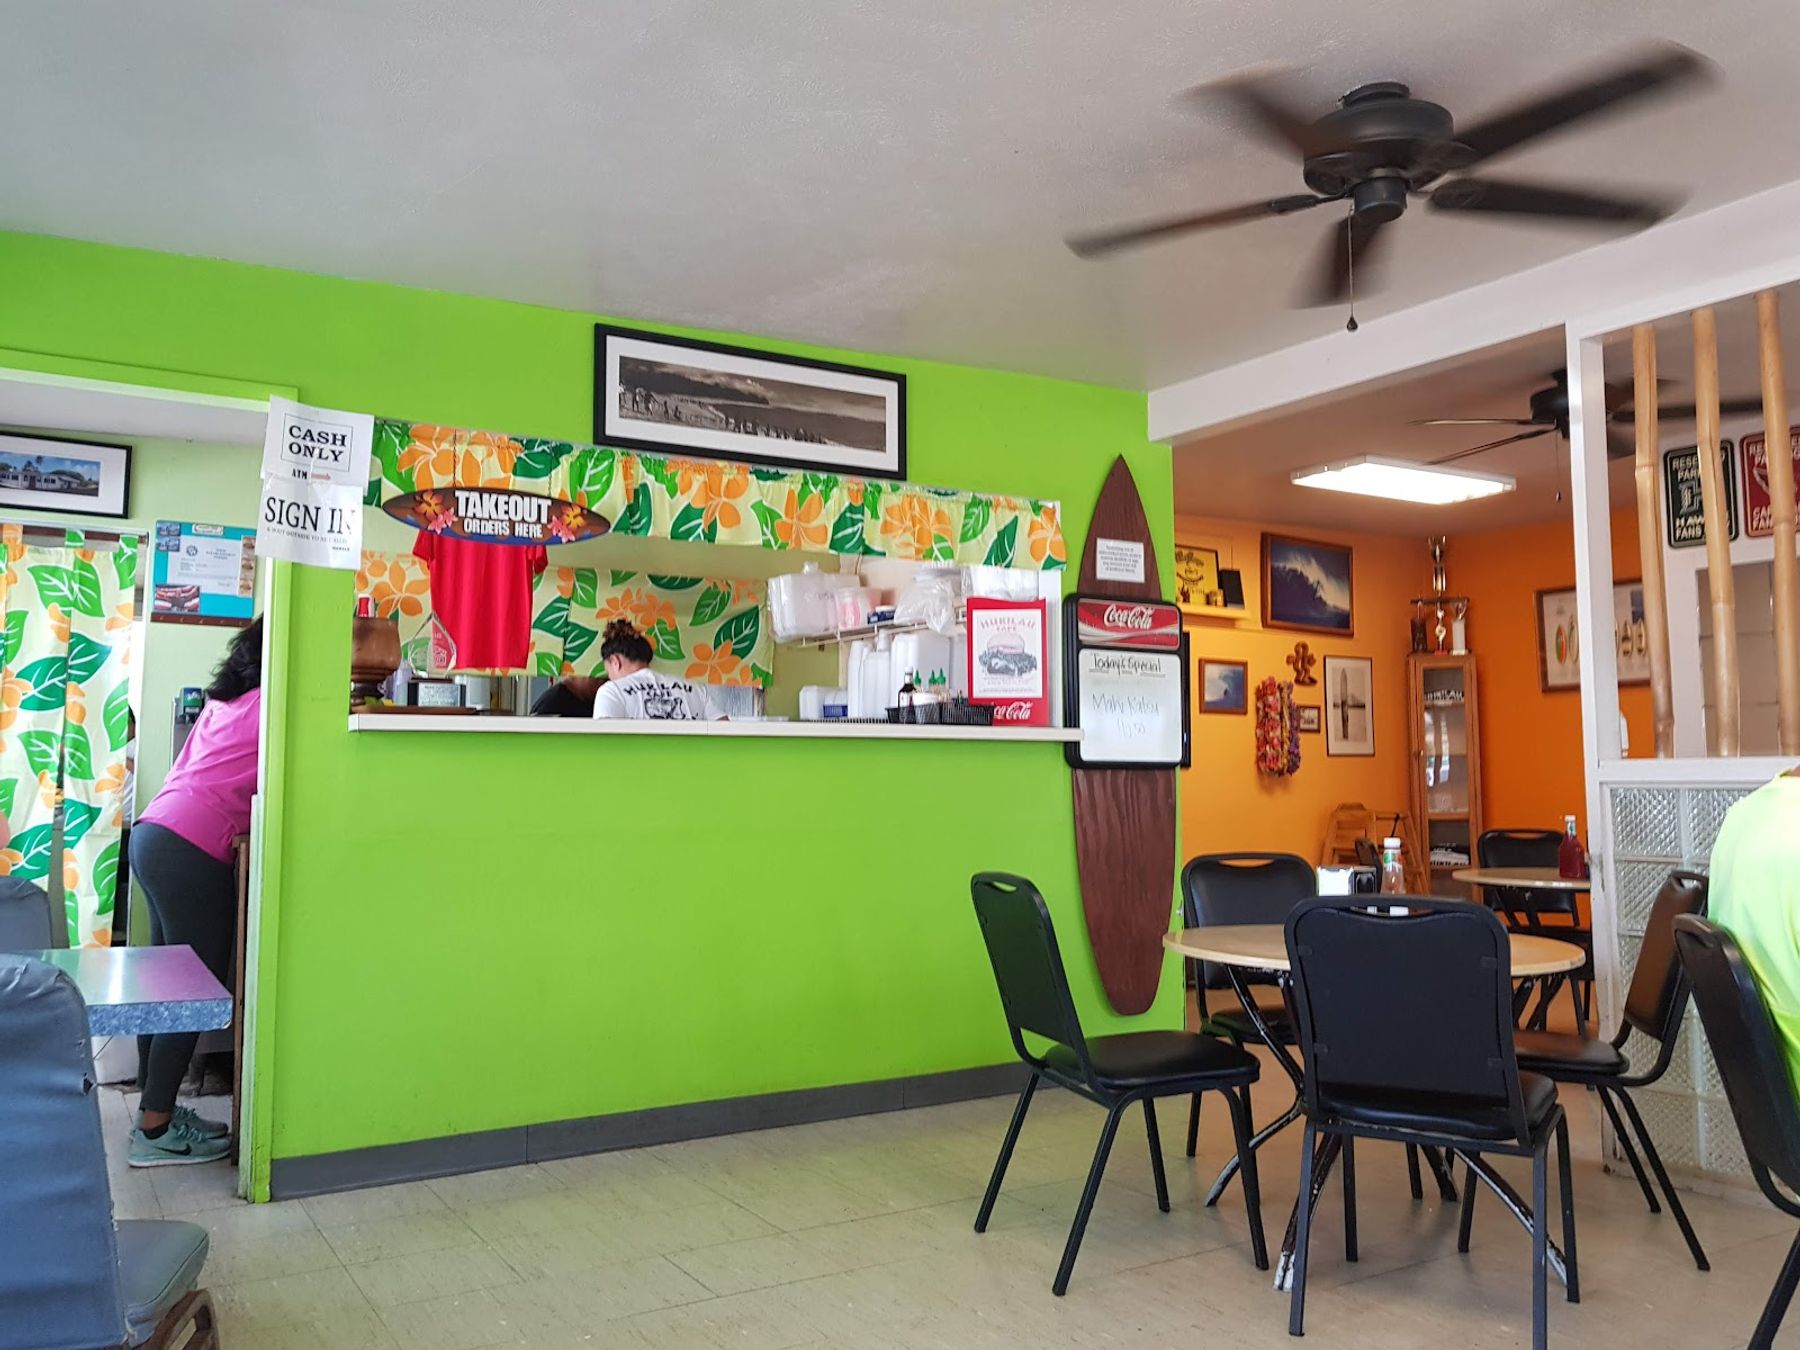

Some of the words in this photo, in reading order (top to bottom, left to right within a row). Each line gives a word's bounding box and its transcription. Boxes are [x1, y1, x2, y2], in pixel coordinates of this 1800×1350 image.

[289, 425, 347, 447] CASH
[289, 442, 344, 463] ONLY
[292, 468, 308, 480] ATM
[265, 496, 321, 532] SIGN
[327, 507, 355, 535] IN
[455, 490, 552, 525] TAKEOUT
[463, 518, 510, 537] ORDERS
[514, 522, 544, 539] HERE
[1128, 656, 1161, 673] Special
